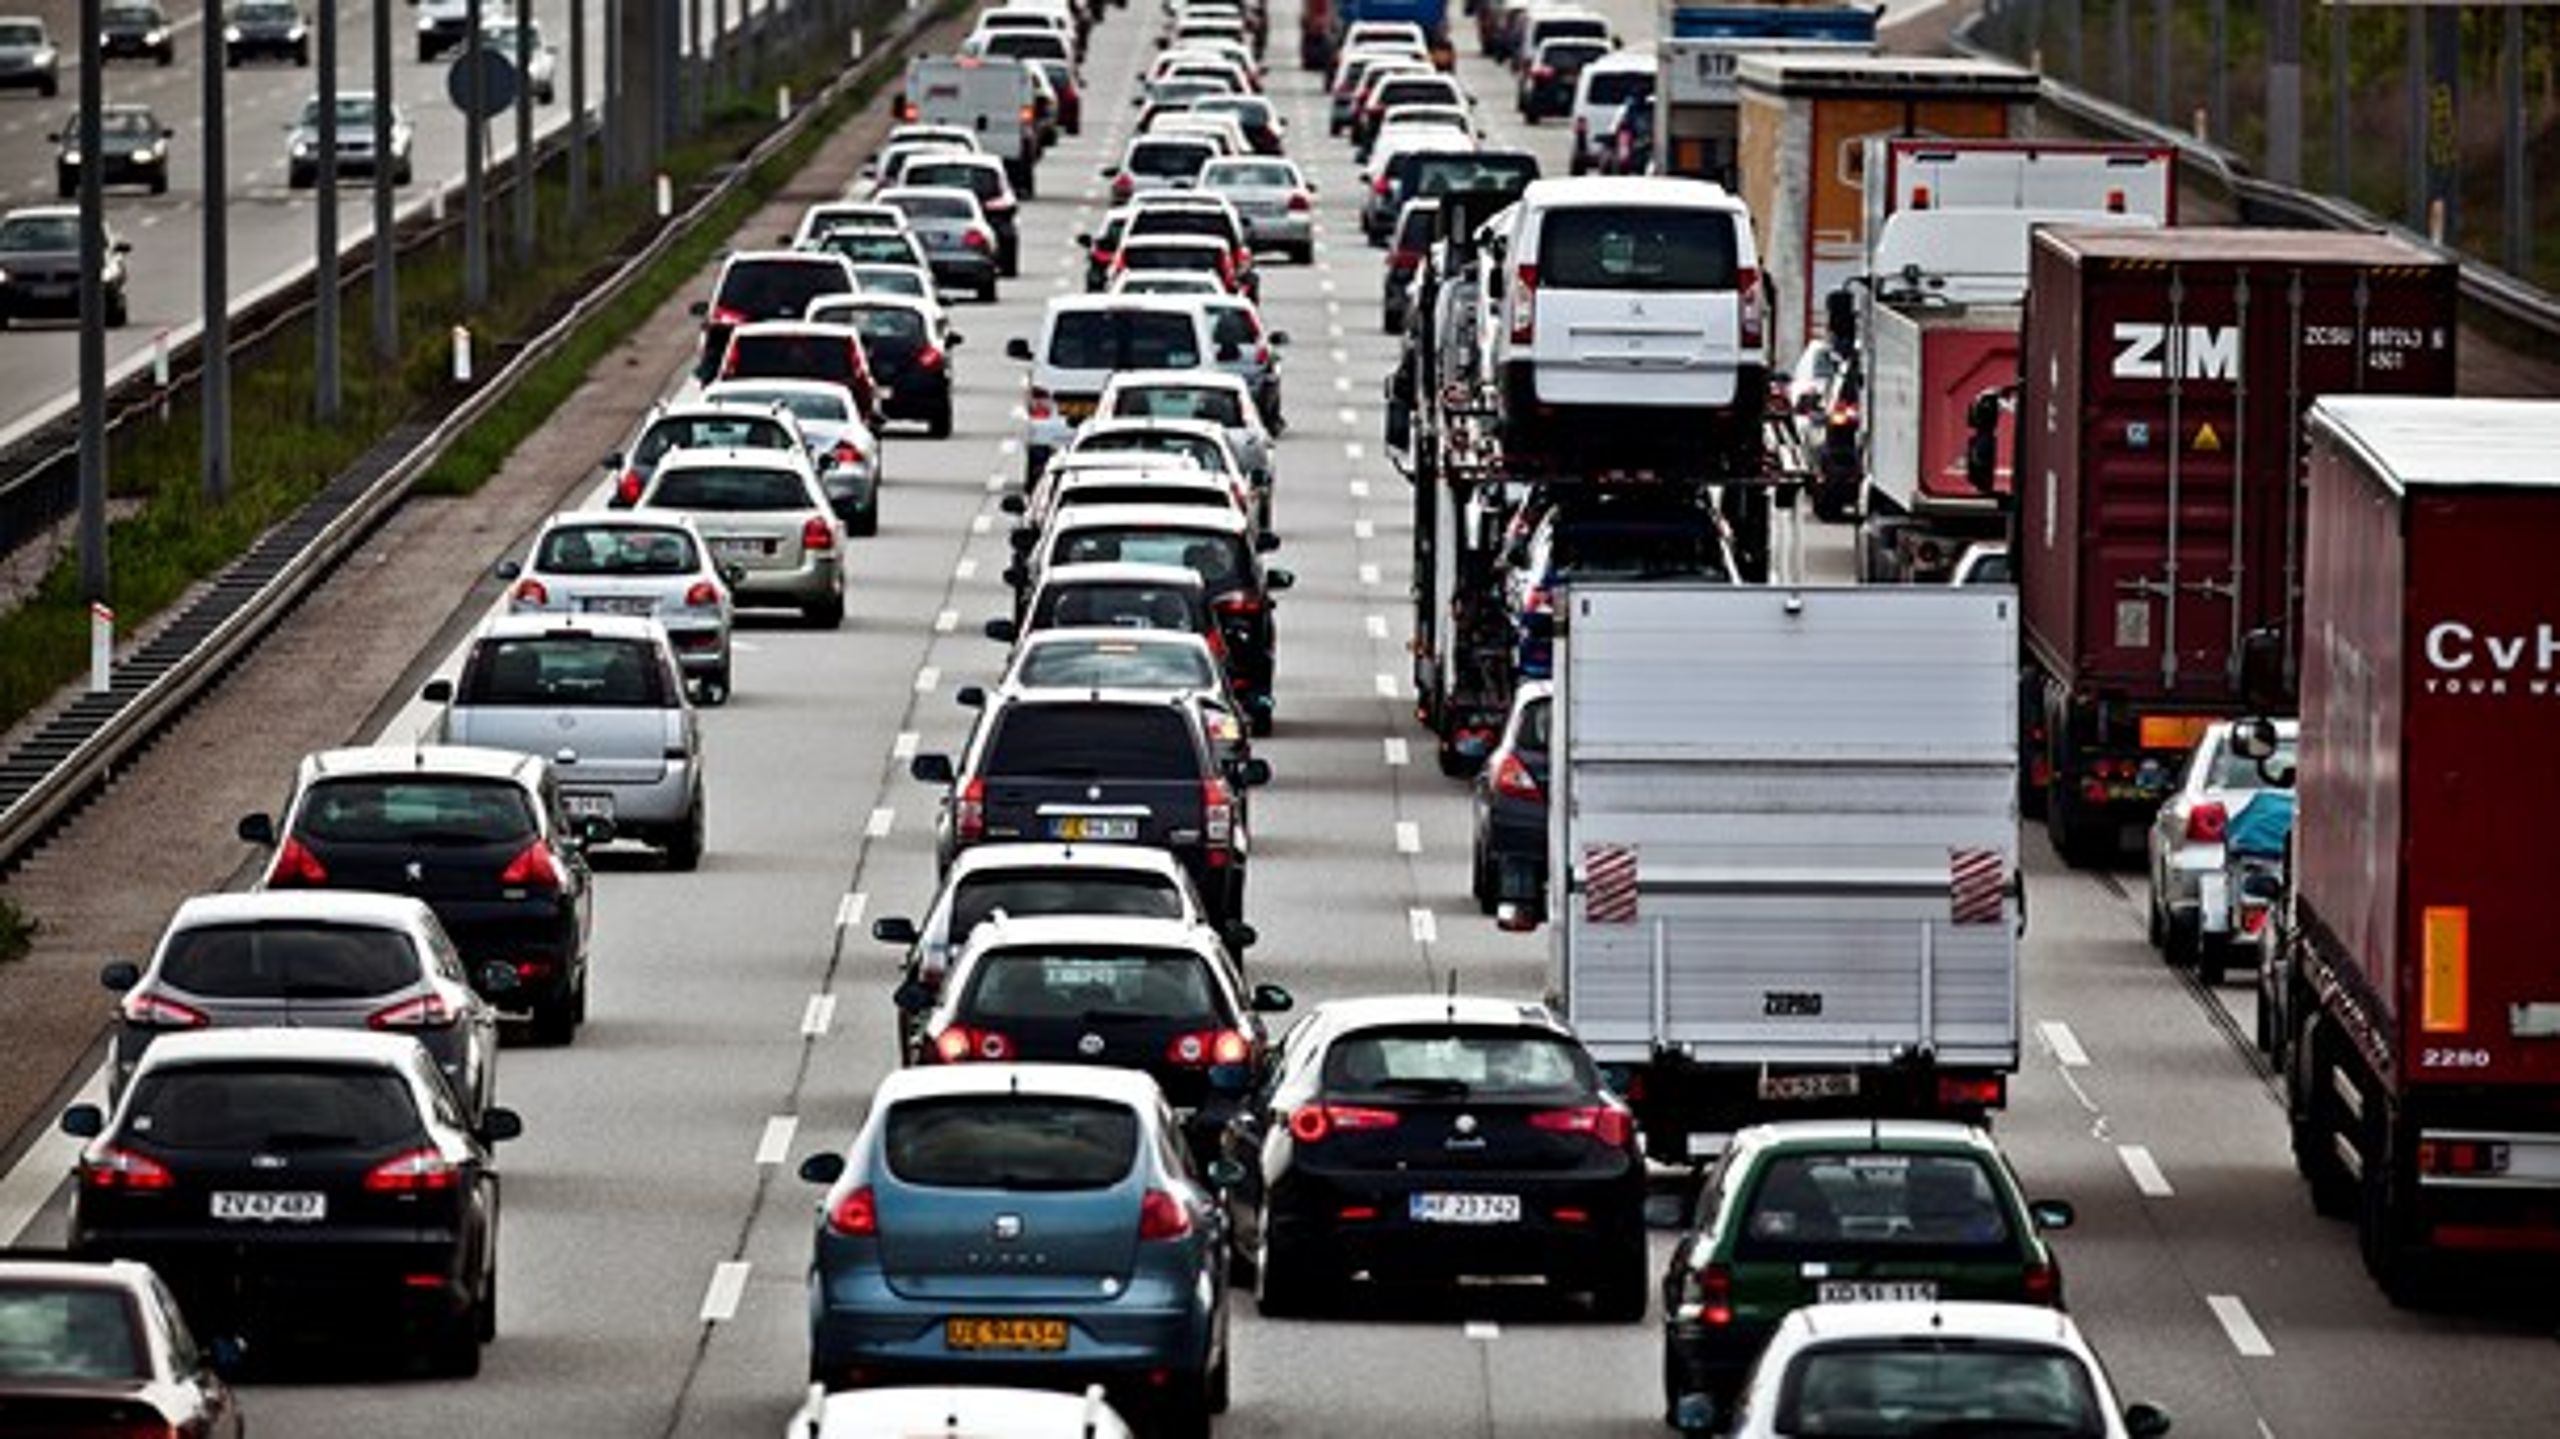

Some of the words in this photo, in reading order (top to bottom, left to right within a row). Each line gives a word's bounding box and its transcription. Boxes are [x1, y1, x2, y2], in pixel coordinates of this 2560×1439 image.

[2112, 322, 2241, 379] ZIM
[2425, 679, 2506, 694] YOUR
[2421, 1049, 2490, 1067] 2280
